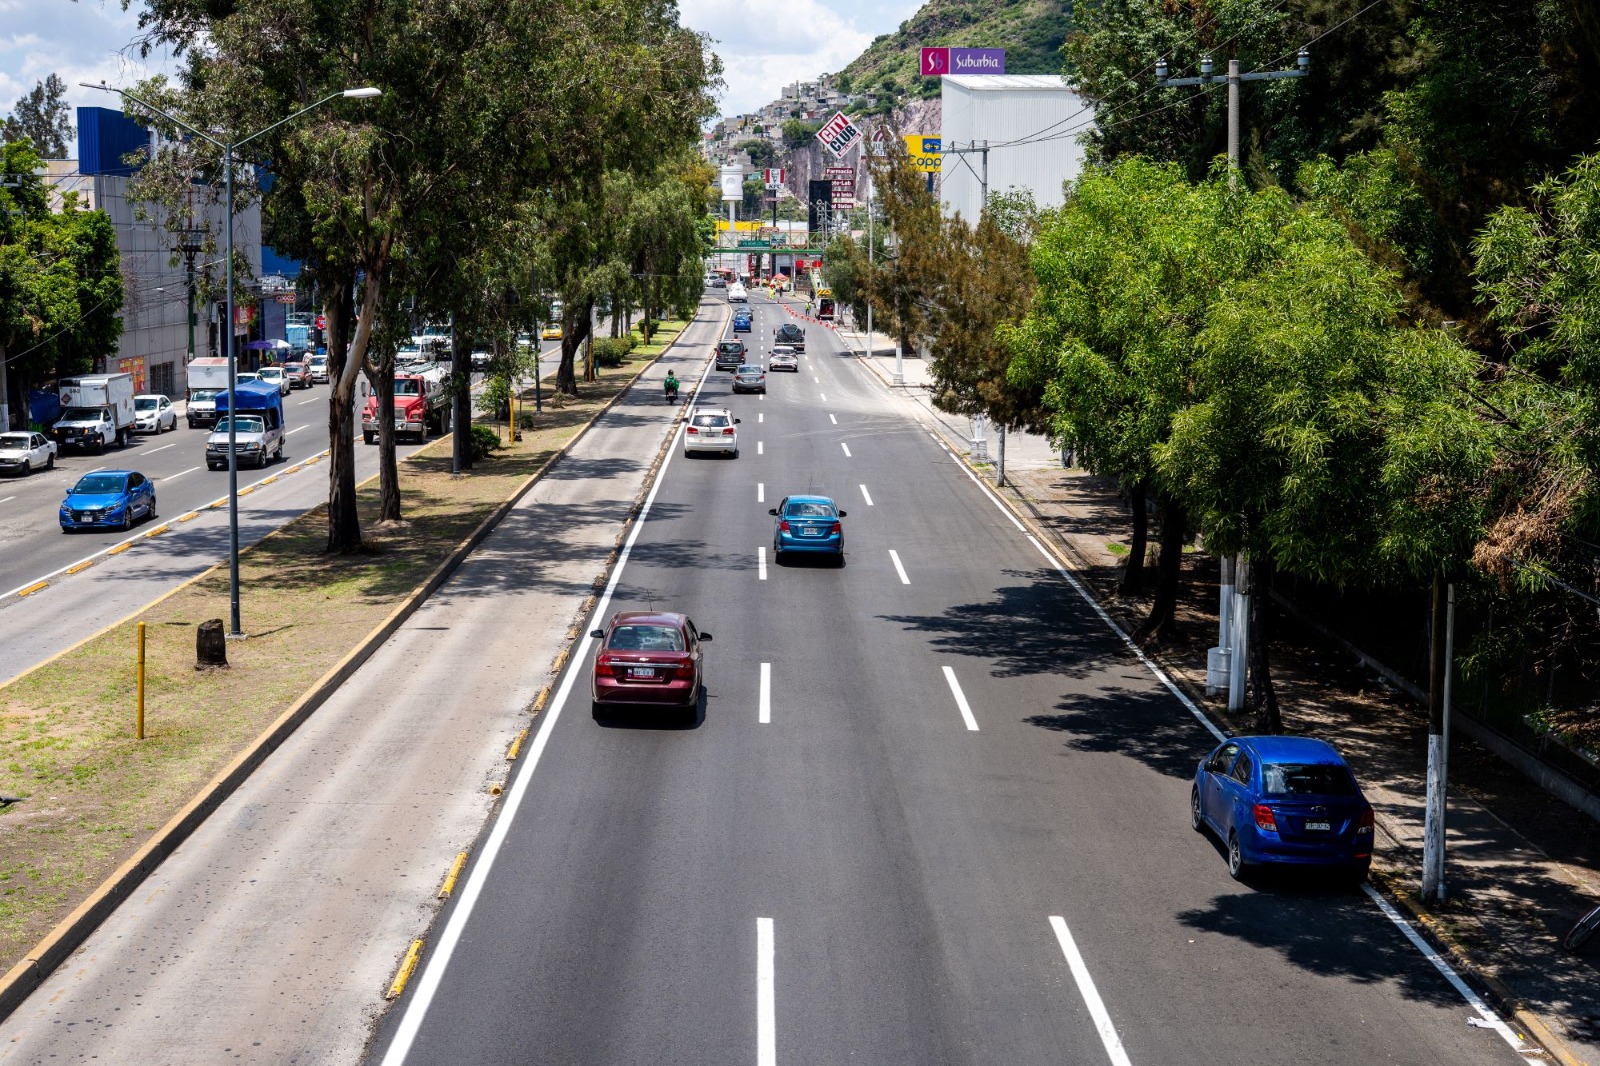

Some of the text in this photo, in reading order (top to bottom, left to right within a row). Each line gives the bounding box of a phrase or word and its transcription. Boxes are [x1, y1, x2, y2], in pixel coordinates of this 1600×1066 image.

[956, 54, 998, 69] Suburbia
[821, 115, 847, 142] CITY
[830, 125, 857, 152] CLUB
